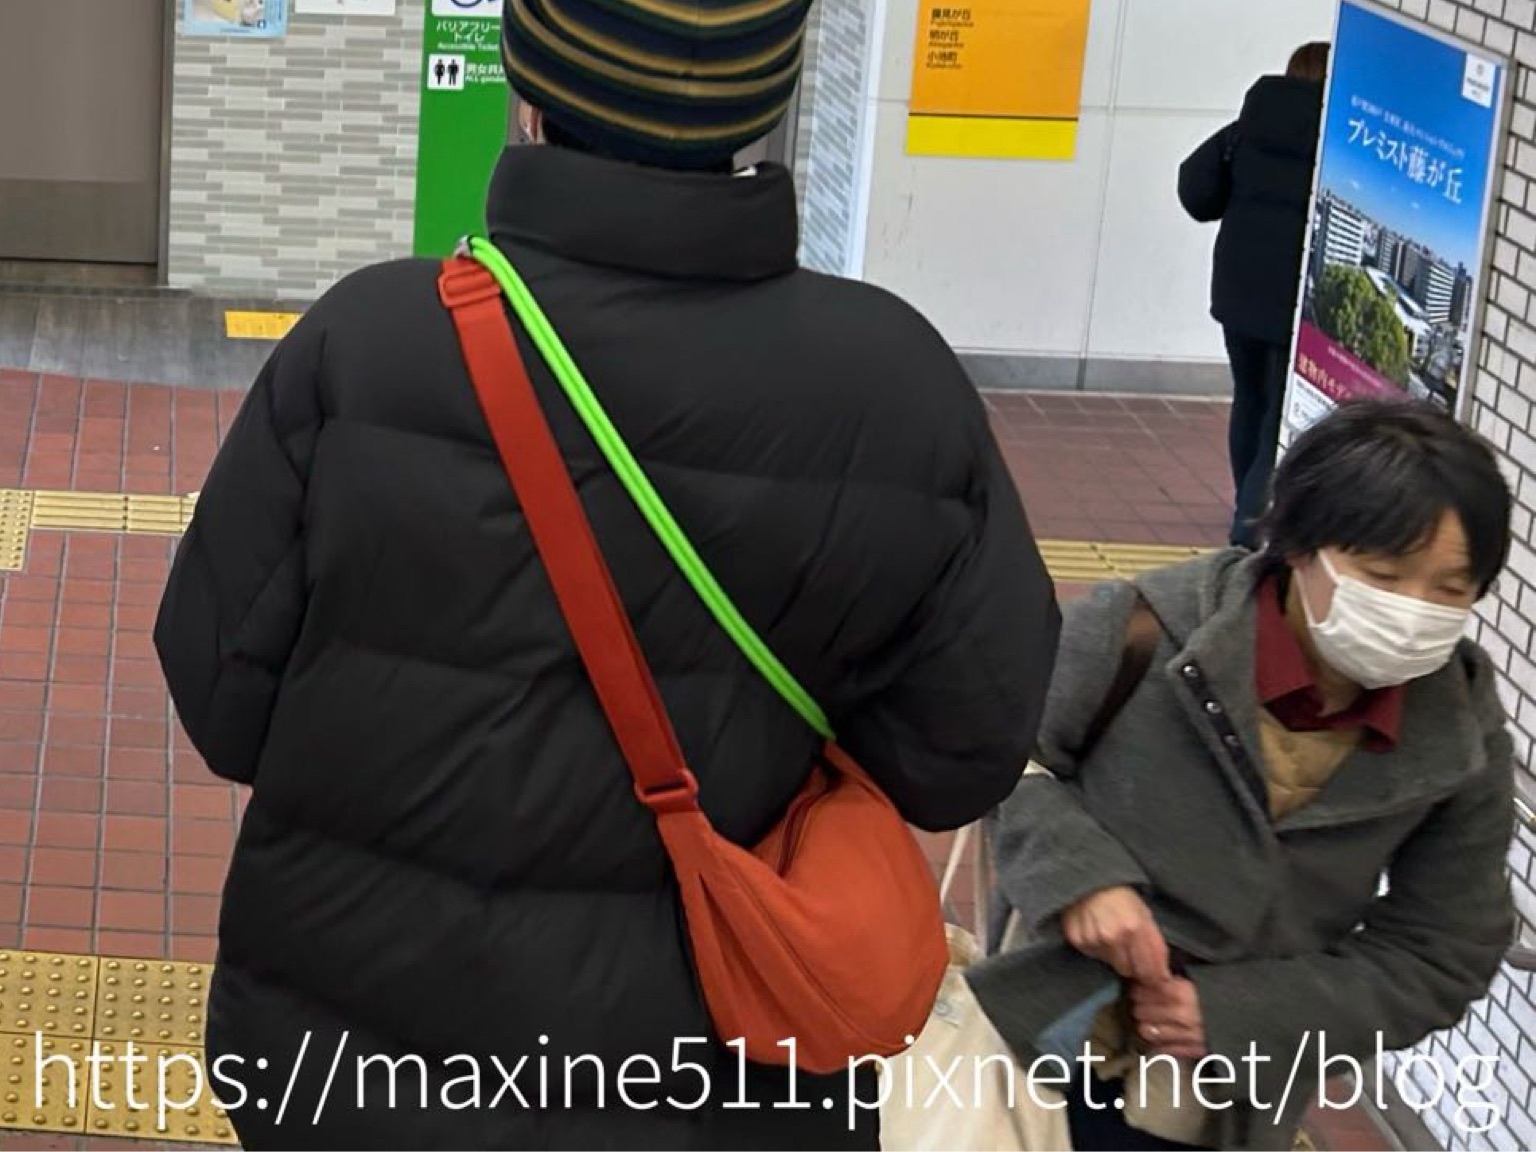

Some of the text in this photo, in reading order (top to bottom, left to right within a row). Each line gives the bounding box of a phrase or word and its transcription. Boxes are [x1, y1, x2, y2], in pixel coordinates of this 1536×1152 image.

[436, 20, 501, 33] バリアフリー
[454, 31, 486, 43] トイレ
[1348, 118, 1463, 205] プレミスト藤が丘
